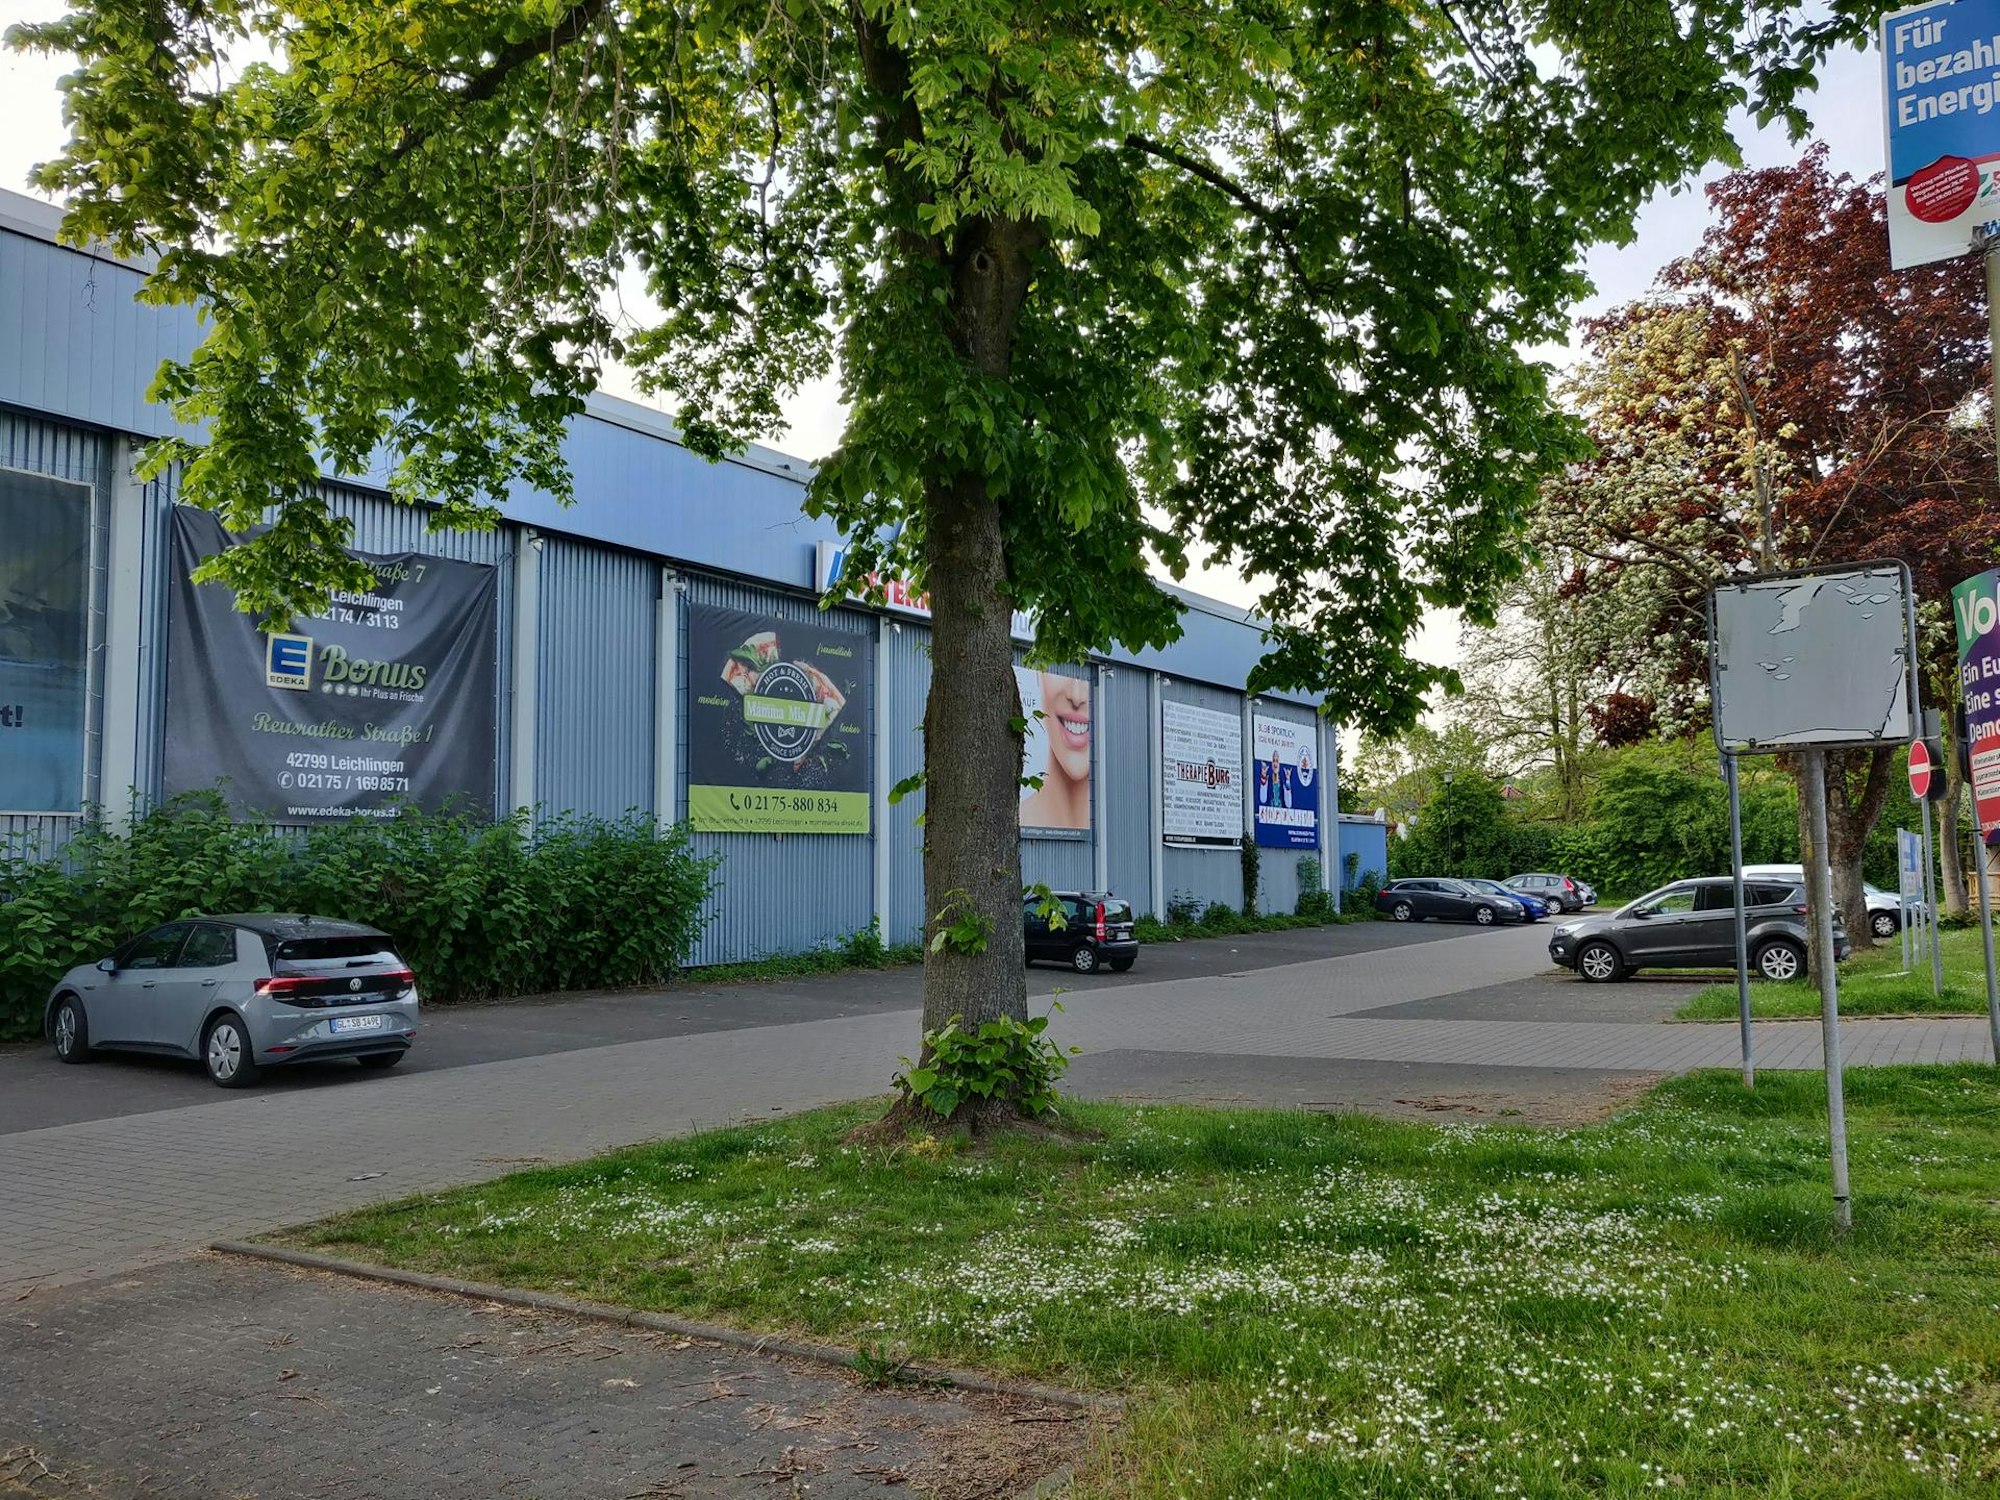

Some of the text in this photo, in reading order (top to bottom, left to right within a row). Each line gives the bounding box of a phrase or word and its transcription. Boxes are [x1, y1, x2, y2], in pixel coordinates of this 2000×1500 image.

[1895, 16, 1947, 55] Für
[362, 561, 426, 584] traße 7
[331, 588, 403, 612] Leichlingen
[319, 644, 427, 690] Bonus
[1963, 662, 1979, 687] Ein
[270, 675, 305, 686] EDEKA
[764, 669, 778, 685] HOT
[787, 668, 809, 690] FRESH
[361, 689, 424, 703] Ihr Plus an Frische
[1965, 691, 1991, 715] Eine
[361, 722, 421, 747] Straße
[425, 724, 434, 743] 1
[287, 752, 404, 775] 42799 Leichlingen
[345, 775, 351, 790] /
